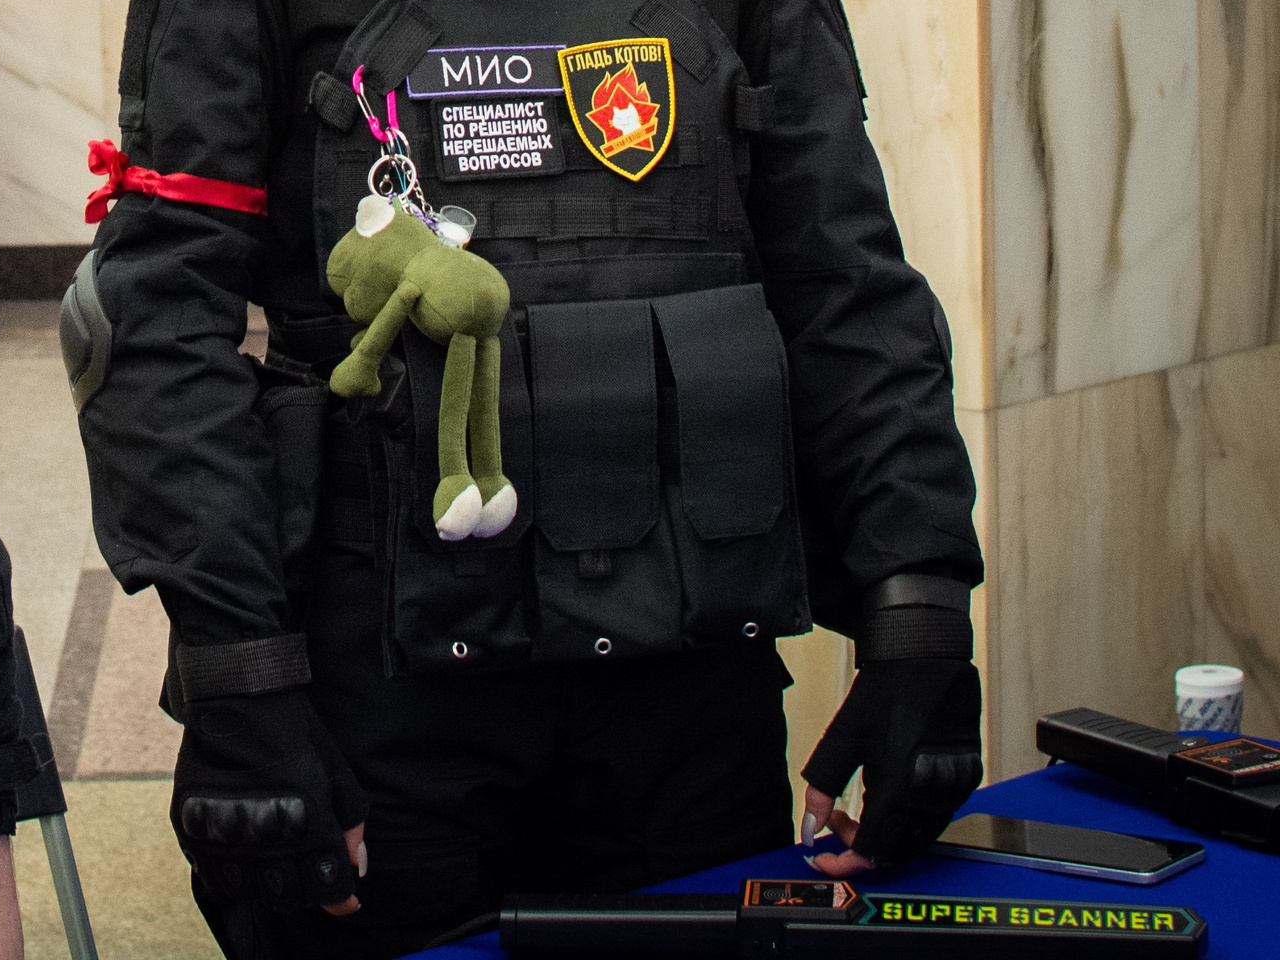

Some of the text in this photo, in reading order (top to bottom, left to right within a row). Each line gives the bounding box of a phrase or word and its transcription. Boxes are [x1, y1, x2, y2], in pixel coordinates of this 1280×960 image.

[441, 54, 533, 87] МИО
[566, 46, 662, 73] ГЛАДЬ КОТОВ!
[442, 101, 544, 123] СПЕЦИАЛИСТ
[443, 119, 548, 139] ПО РЕШЕНИЮ
[443, 134, 553, 156] НЕРЕШАЕМЫХ
[459, 153, 542, 172] ВОПРОСОВ
[881, 900, 1175, 931] SUPER SCANNER
